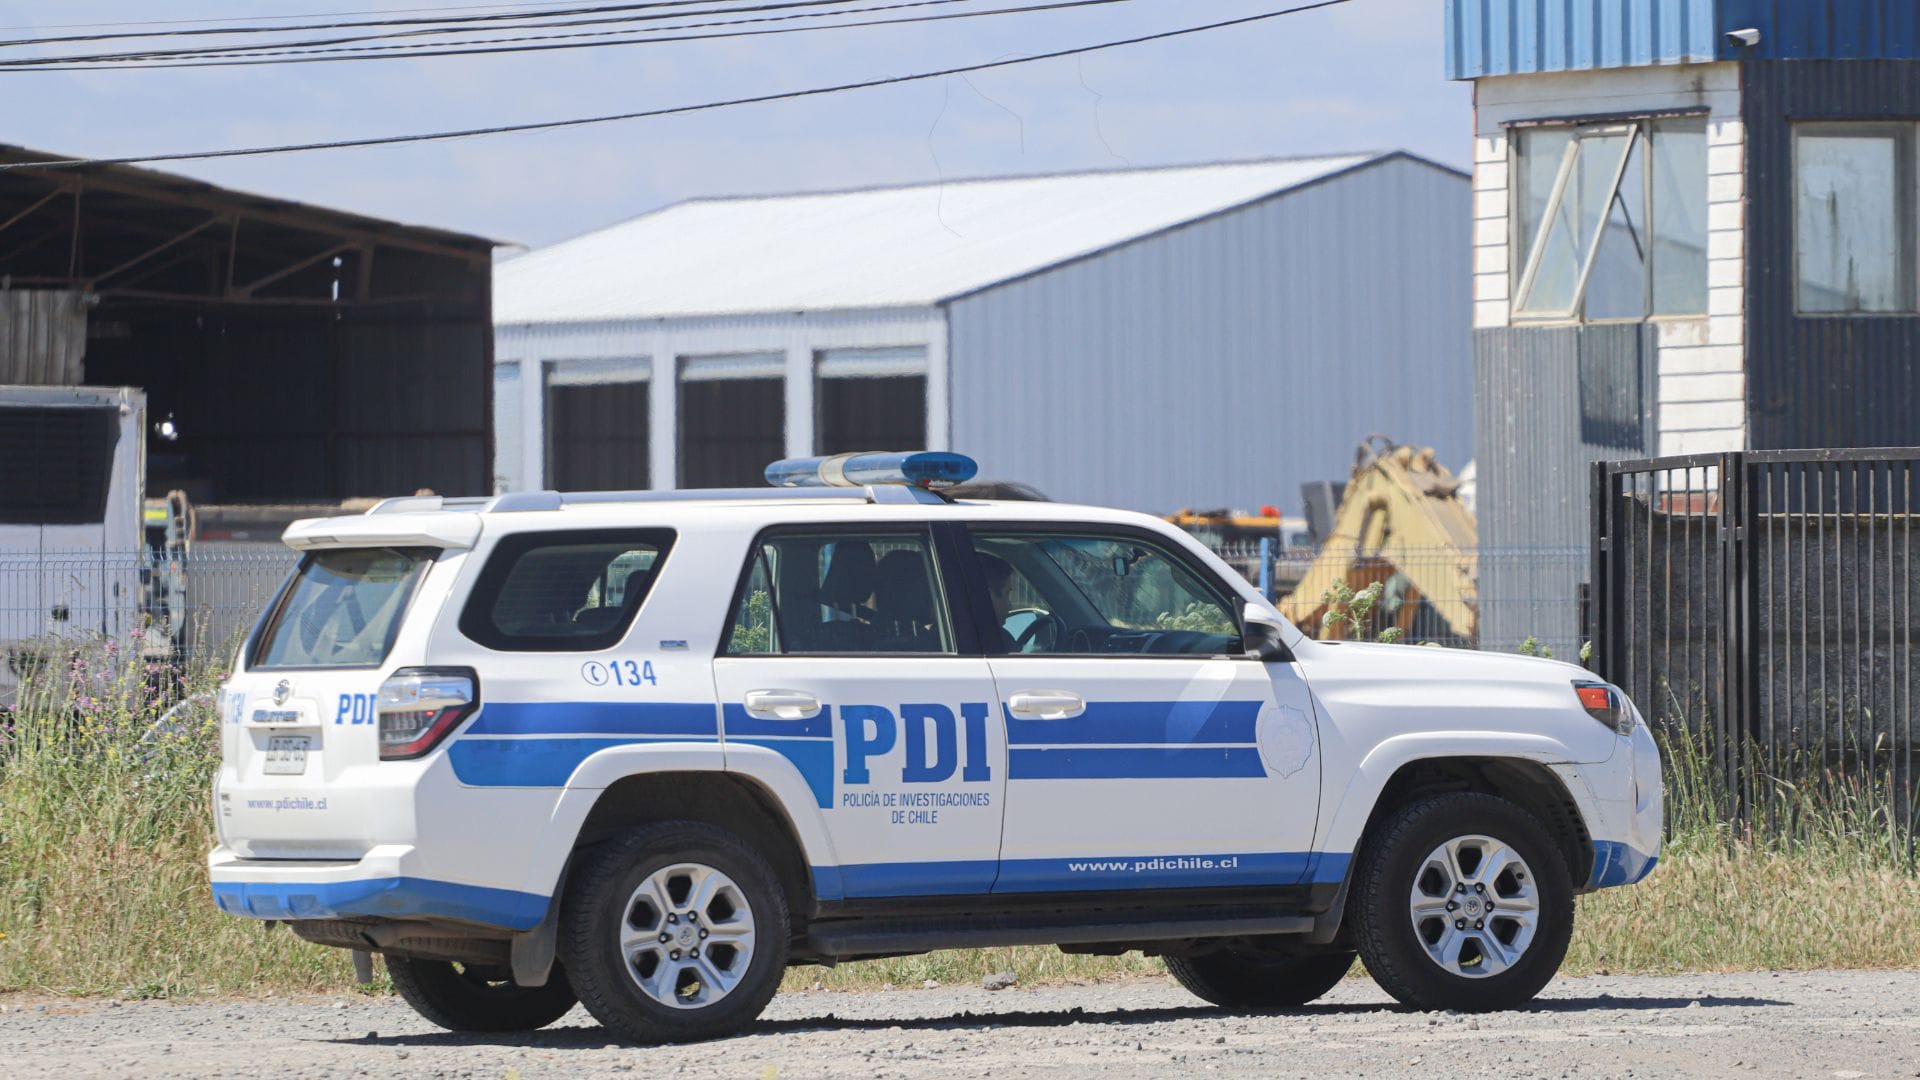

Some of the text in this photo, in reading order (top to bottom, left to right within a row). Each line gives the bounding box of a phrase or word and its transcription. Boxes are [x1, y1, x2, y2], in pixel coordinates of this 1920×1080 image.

[609, 660, 657, 687] 134
[335, 692, 376, 726] PDI
[840, 703, 991, 785] PDI
[247, 797, 328, 812] www.pdichile.cl
[843, 790, 990, 807] POLICÍA DE INVESTIGACIONES
[892, 810, 938, 824] DE CHILE
[1068, 856, 1239, 873] www.pdichile.cl
